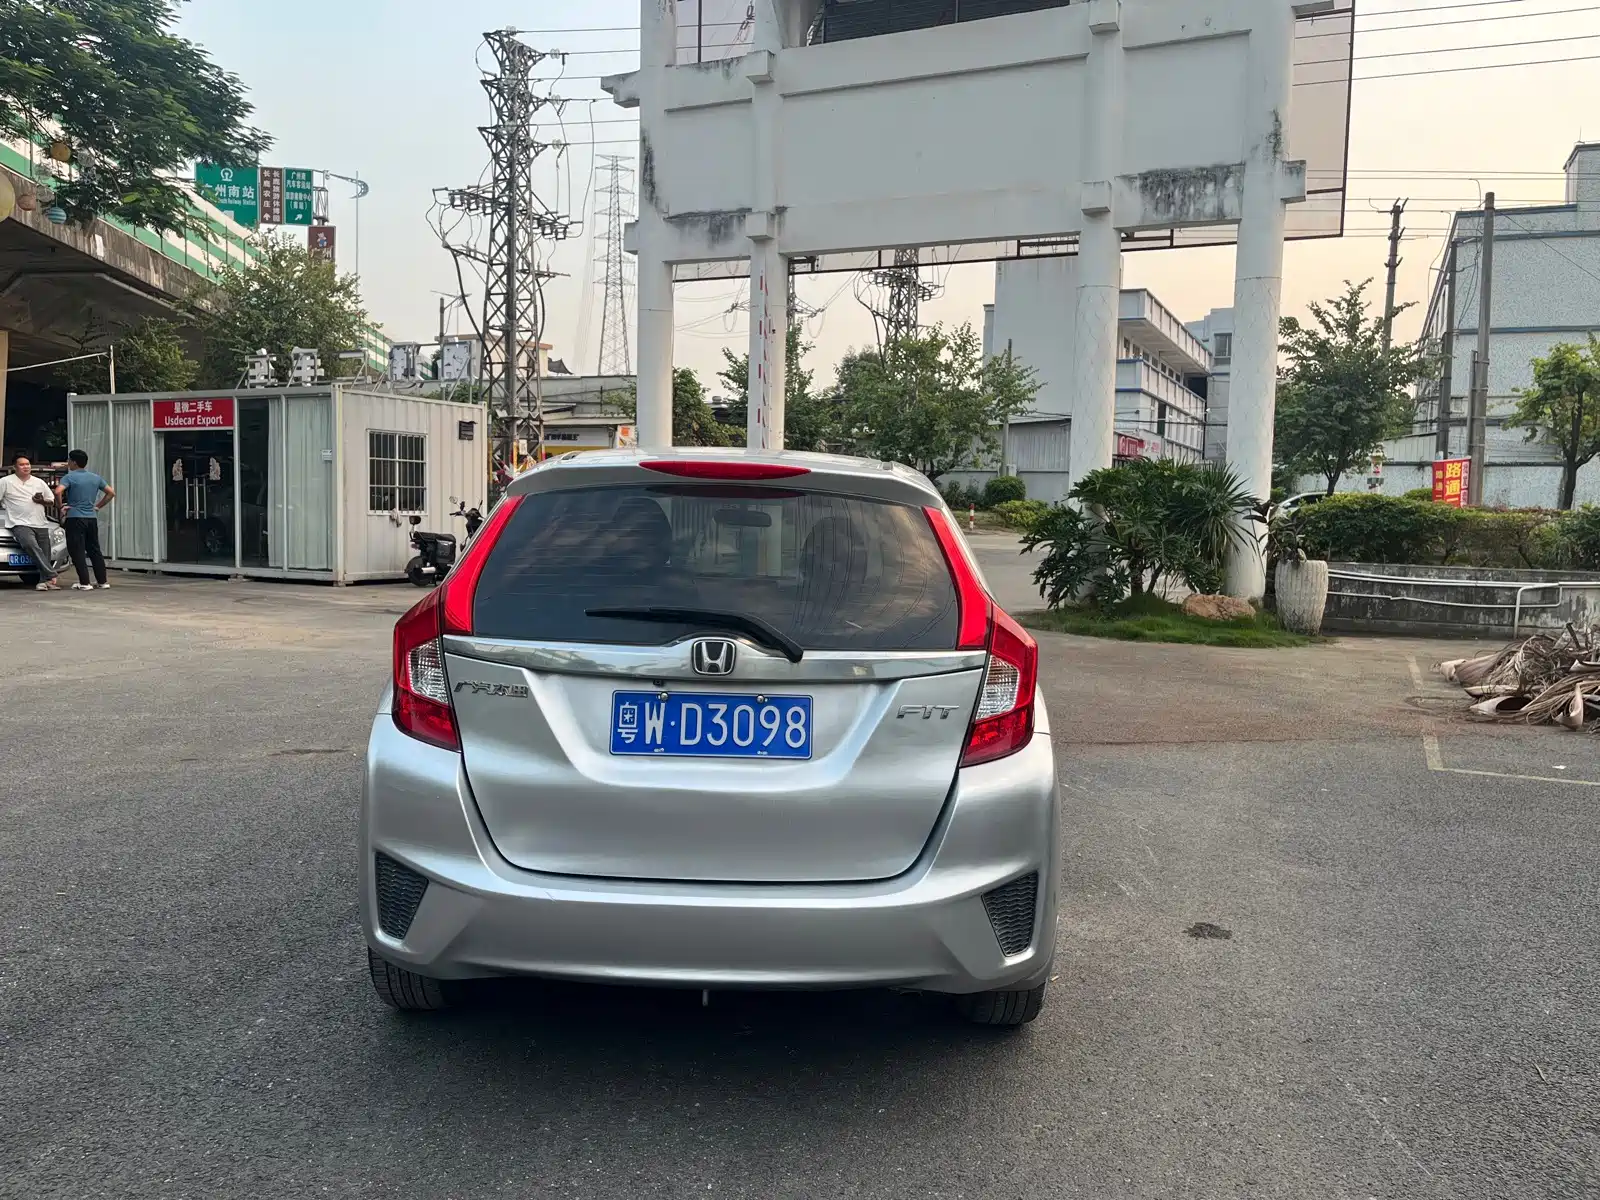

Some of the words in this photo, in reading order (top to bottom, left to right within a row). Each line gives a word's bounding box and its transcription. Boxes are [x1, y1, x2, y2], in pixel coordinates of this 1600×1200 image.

[164, 415, 195, 426] Usdecar
[197, 415, 223, 427] Export
[454, 680, 528, 698] 广汽本田
[897, 704, 960, 720] FIT
